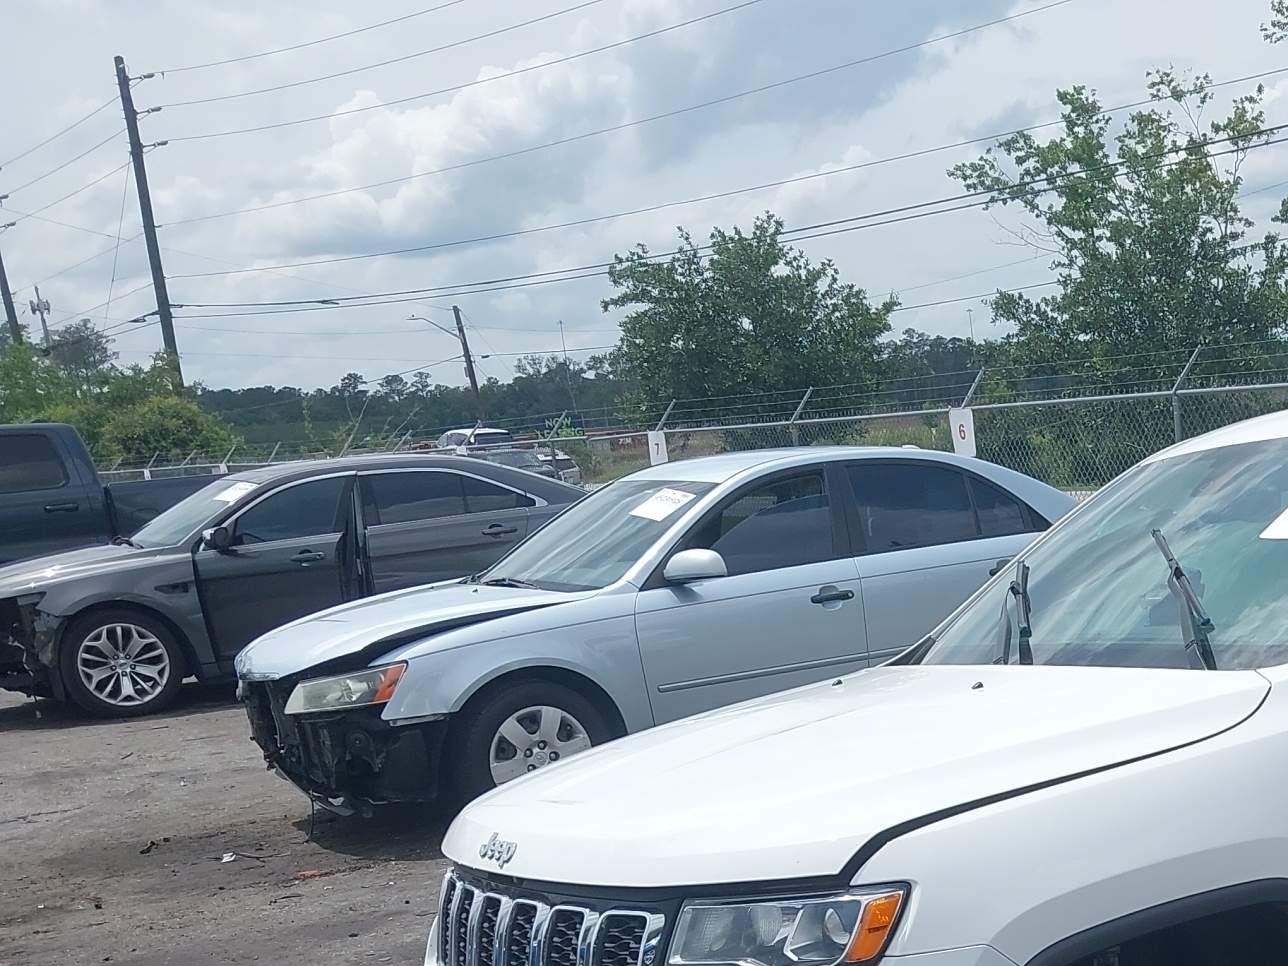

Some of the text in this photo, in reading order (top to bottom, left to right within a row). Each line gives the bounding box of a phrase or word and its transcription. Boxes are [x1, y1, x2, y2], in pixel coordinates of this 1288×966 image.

[959, 423, 966, 440] 6
[655, 442, 660, 456] 7
[479, 832, 517, 869] Jeep
